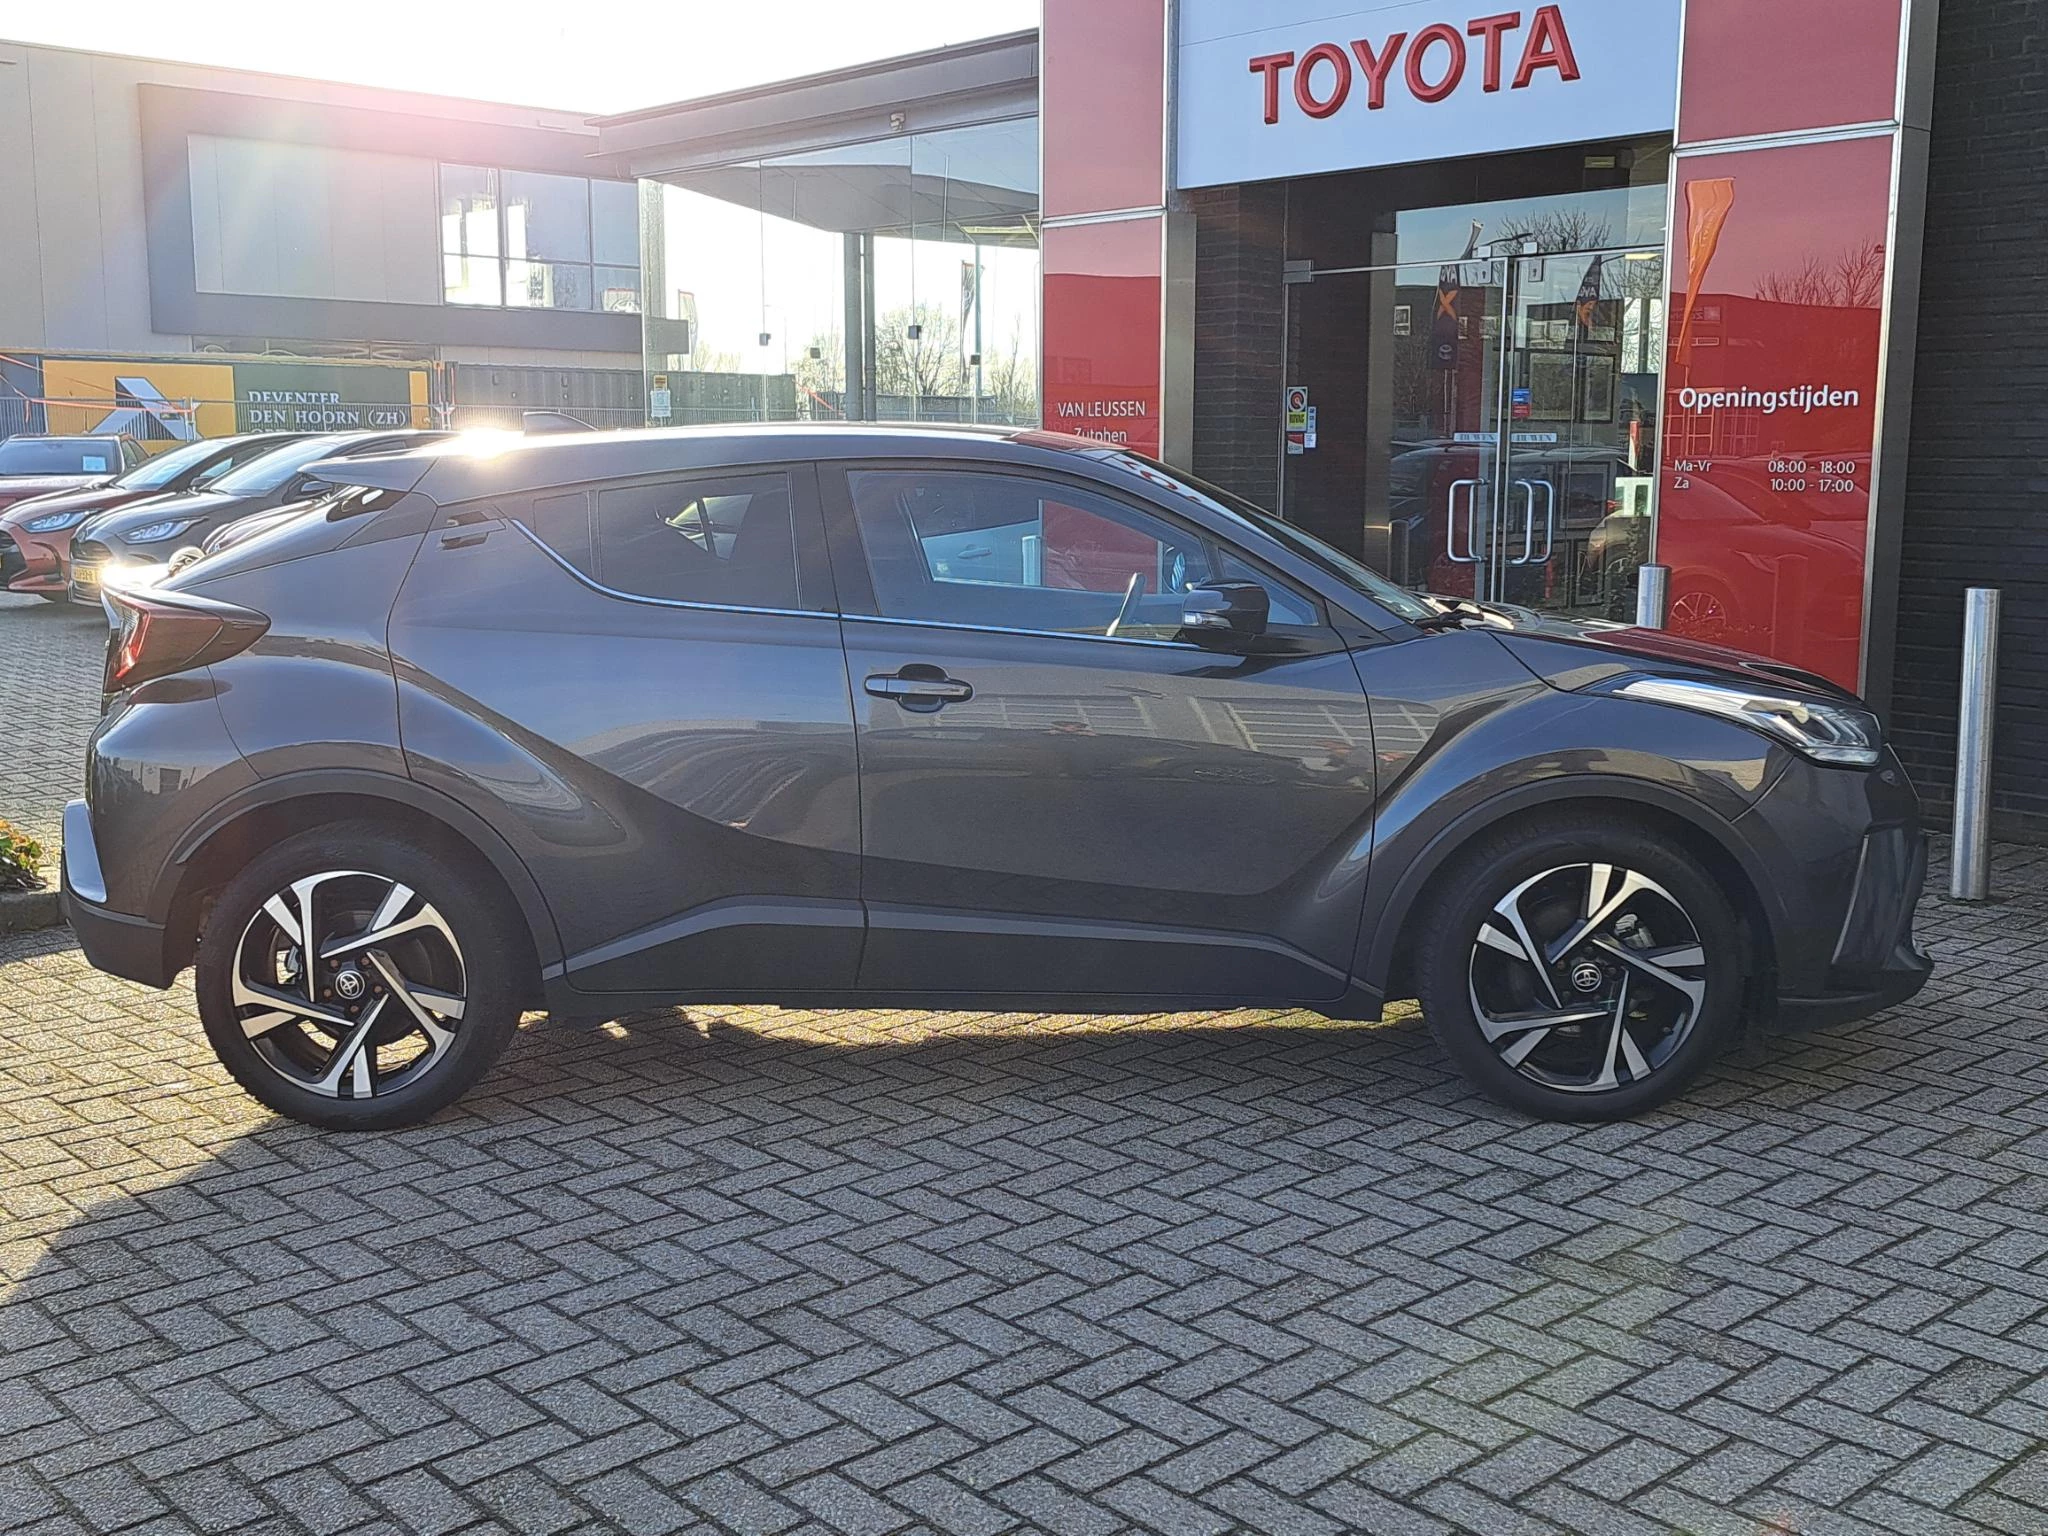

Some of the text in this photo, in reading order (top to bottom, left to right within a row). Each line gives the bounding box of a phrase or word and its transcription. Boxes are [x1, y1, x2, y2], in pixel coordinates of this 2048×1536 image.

[1249, 4, 1581, 124] TOYOTA
[248, 391, 341, 404] DEVENTER
[1679, 386, 1859, 414] Openingstijden
[249, 408, 407, 427] DEN HOORN (ZH)
[1057, 401, 1146, 417] VAN LEUSSEN
[1673, 459, 1713, 472] Ma-Vr
[1768, 460, 1807, 474] 08:00
[1820, 461, 1856, 475] 18:00
[1673, 476, 1690, 490] Za
[1771, 478, 1806, 492] 10:00
[1819, 479, 1854, 493] 17:00
